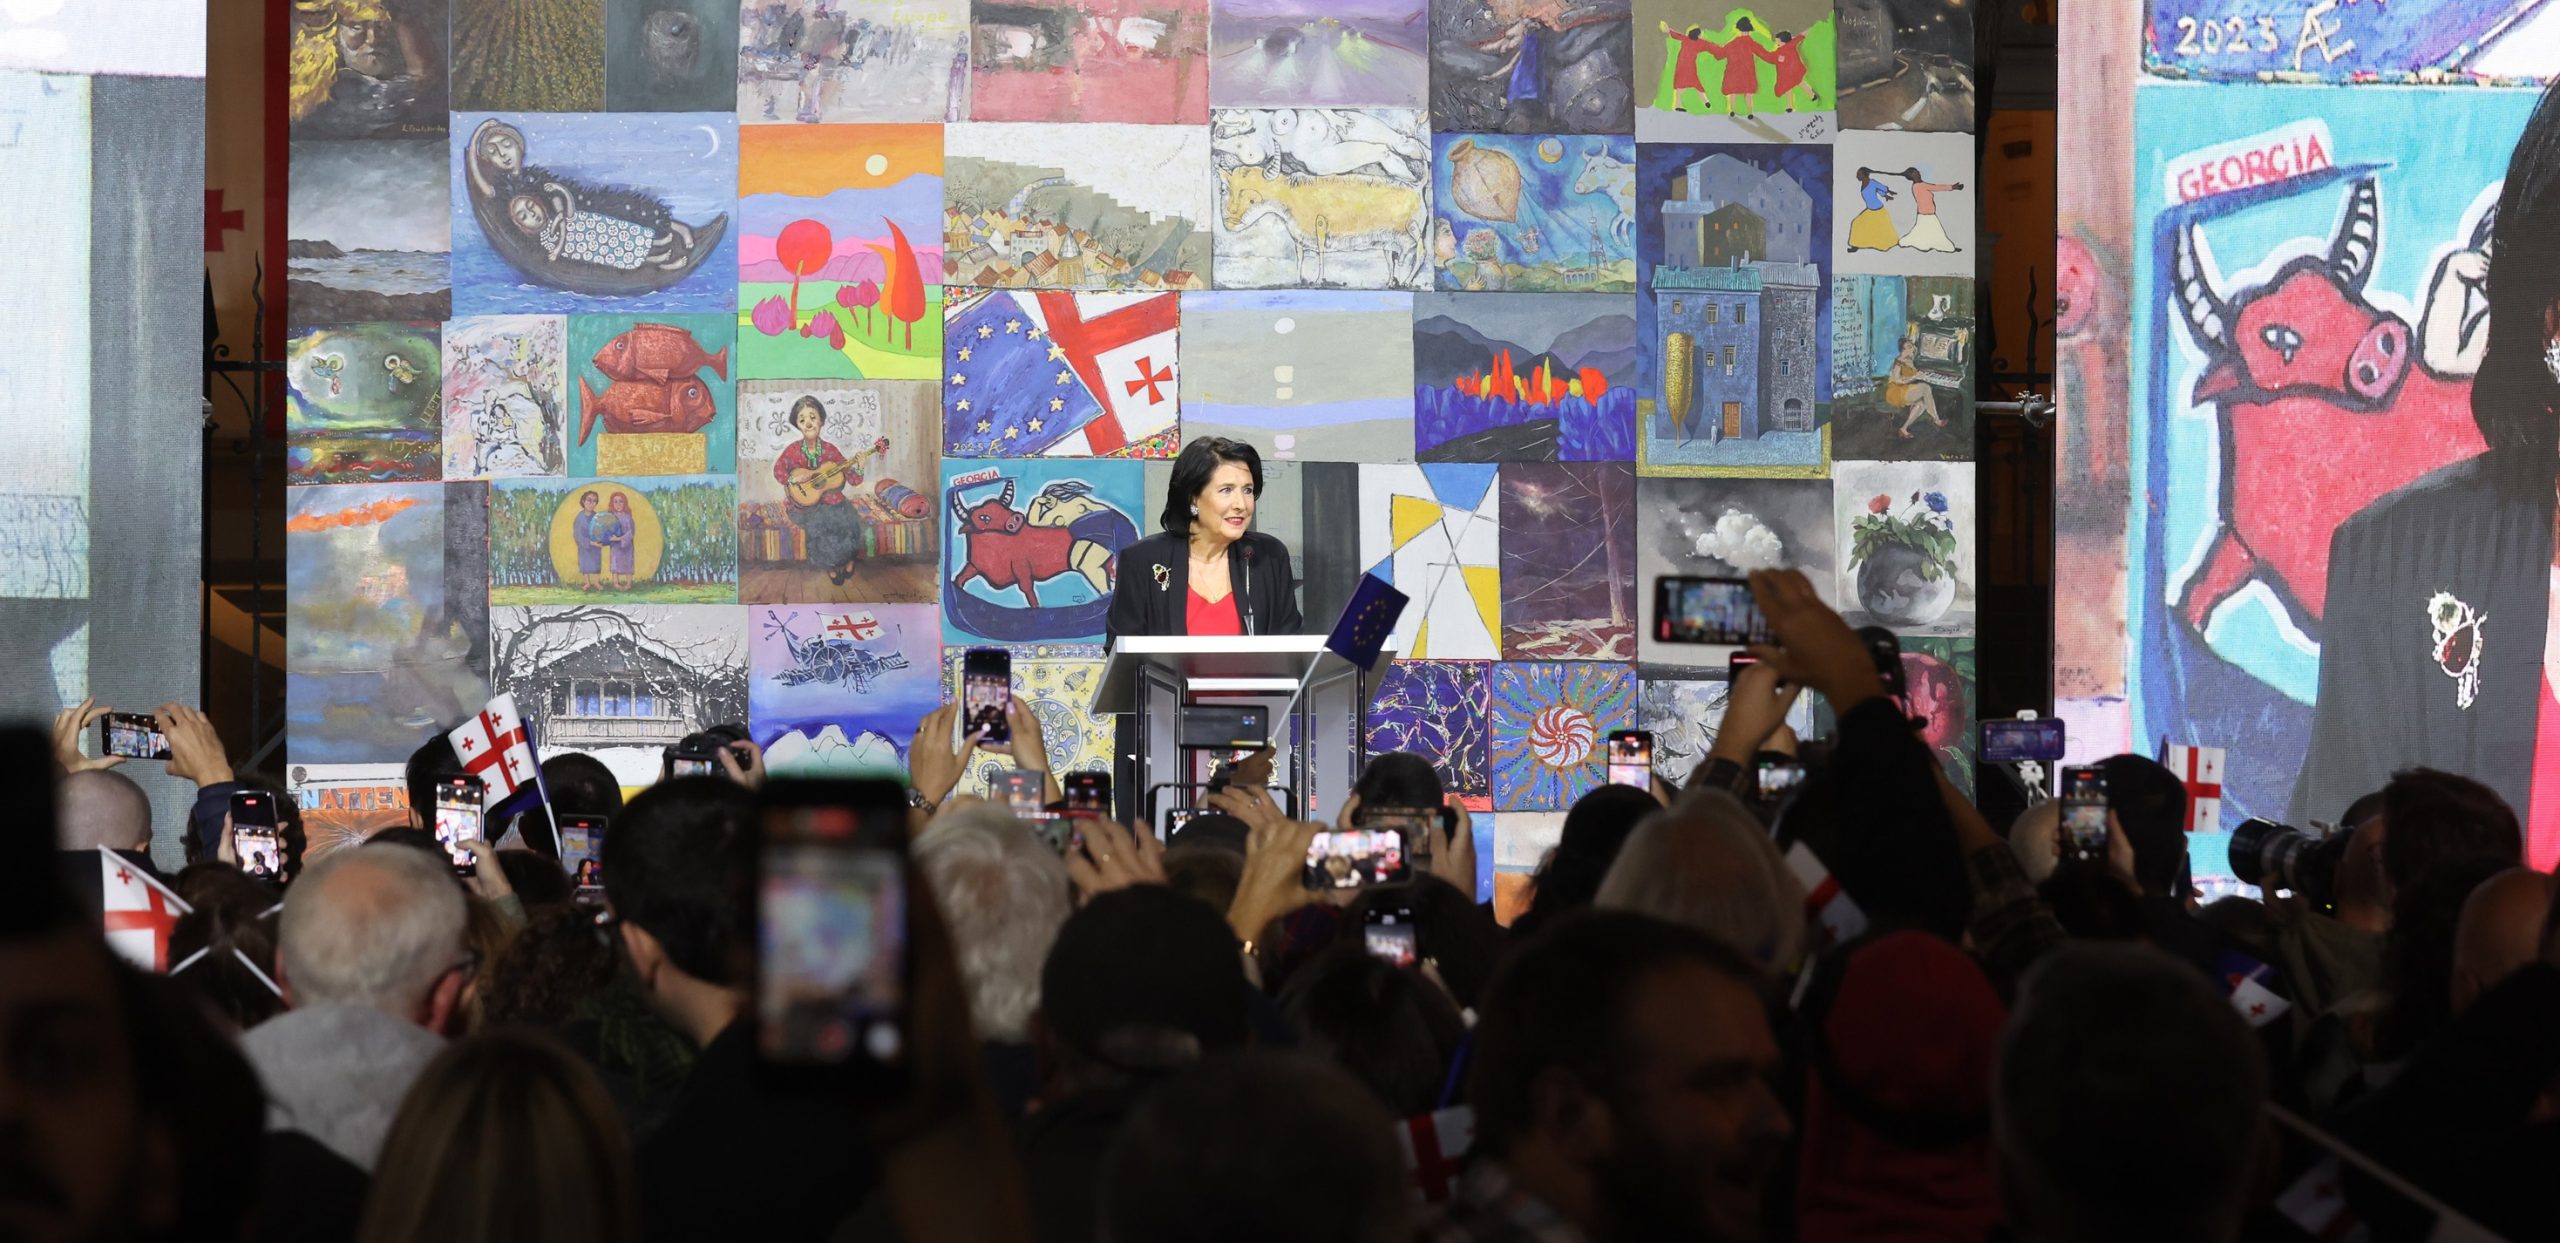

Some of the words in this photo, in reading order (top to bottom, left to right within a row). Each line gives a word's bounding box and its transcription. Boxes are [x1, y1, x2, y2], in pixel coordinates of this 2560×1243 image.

[2174, 16, 2279, 55] 2023
[2177, 133, 2332, 202] GEORGIA
[953, 469, 999, 487] GEORGIA
